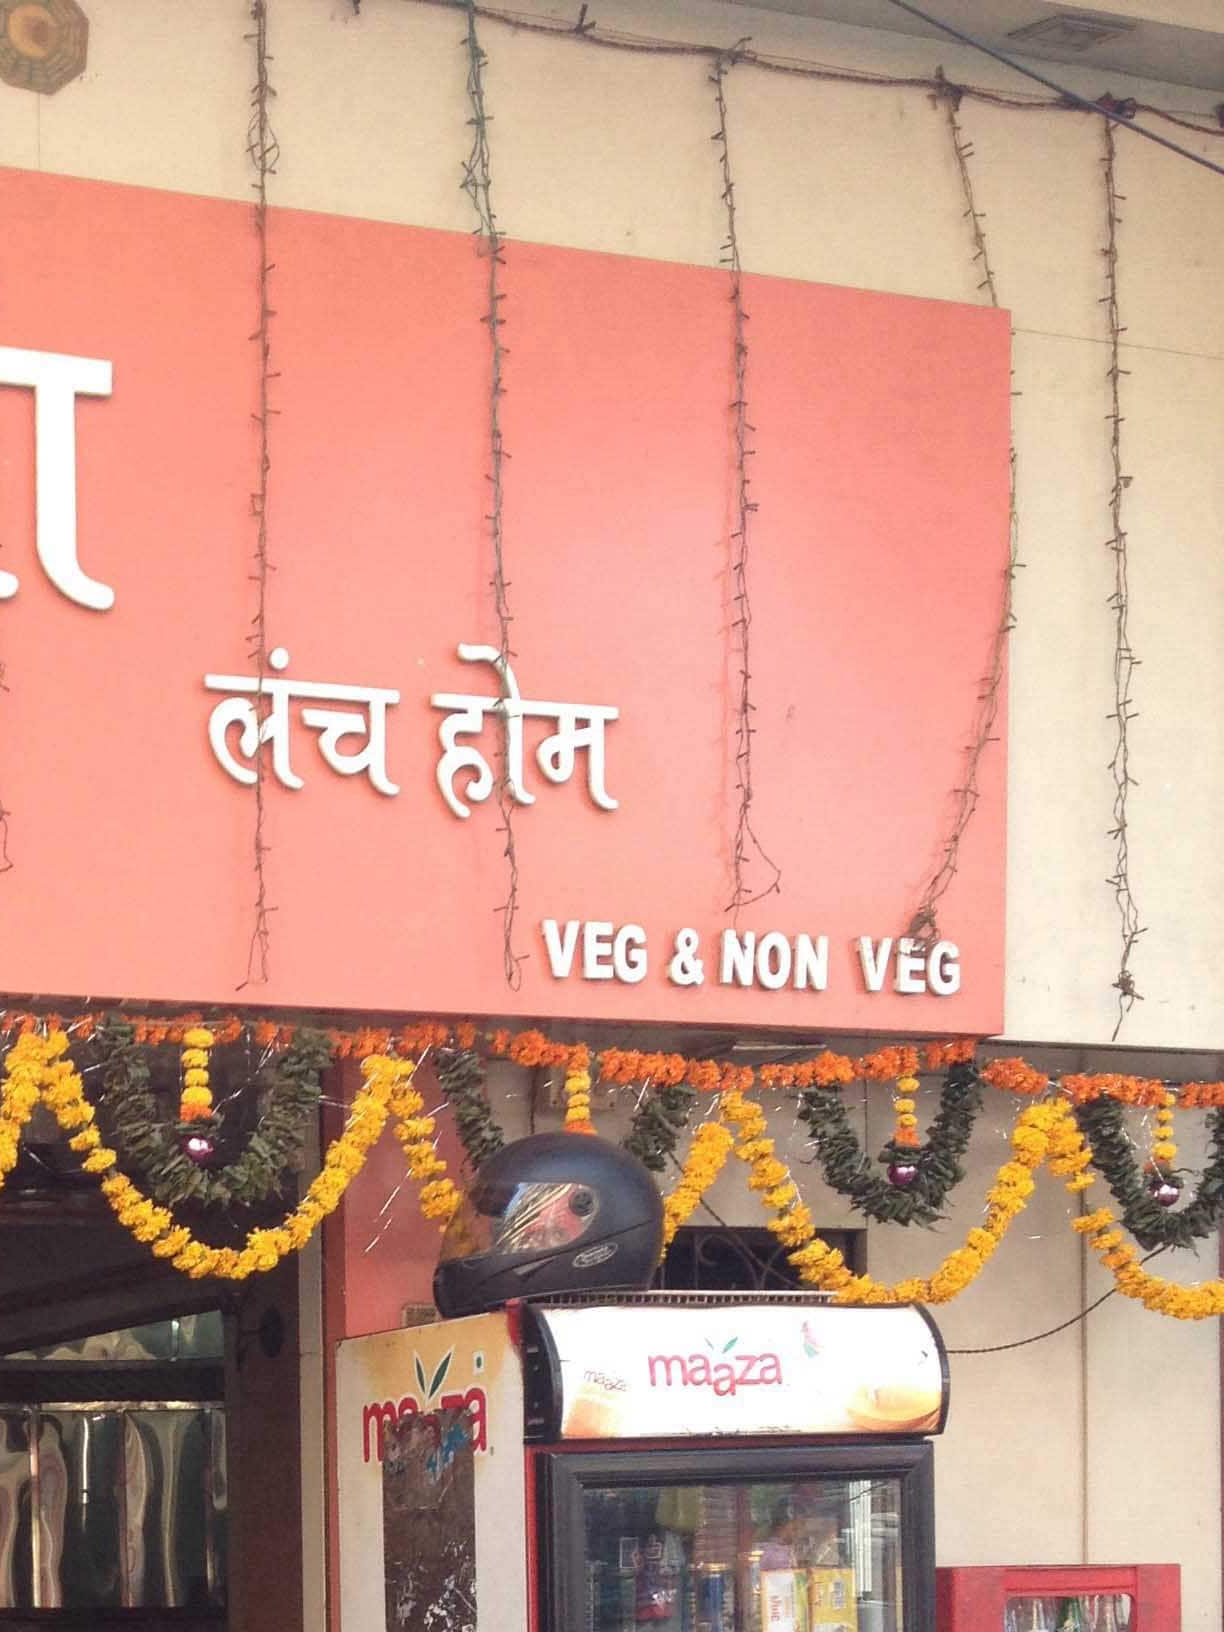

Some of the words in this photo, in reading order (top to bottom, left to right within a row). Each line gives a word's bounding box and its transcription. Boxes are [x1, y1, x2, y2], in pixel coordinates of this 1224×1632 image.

[203, 647, 401, 797] लंच
[430, 643, 620, 820] होम
[541, 918, 648, 984] VEG
[668, 926, 705, 986] &
[720, 928, 829, 991] NON
[856, 934, 961, 996] VEG
[647, 1352, 783, 1397] maaza
